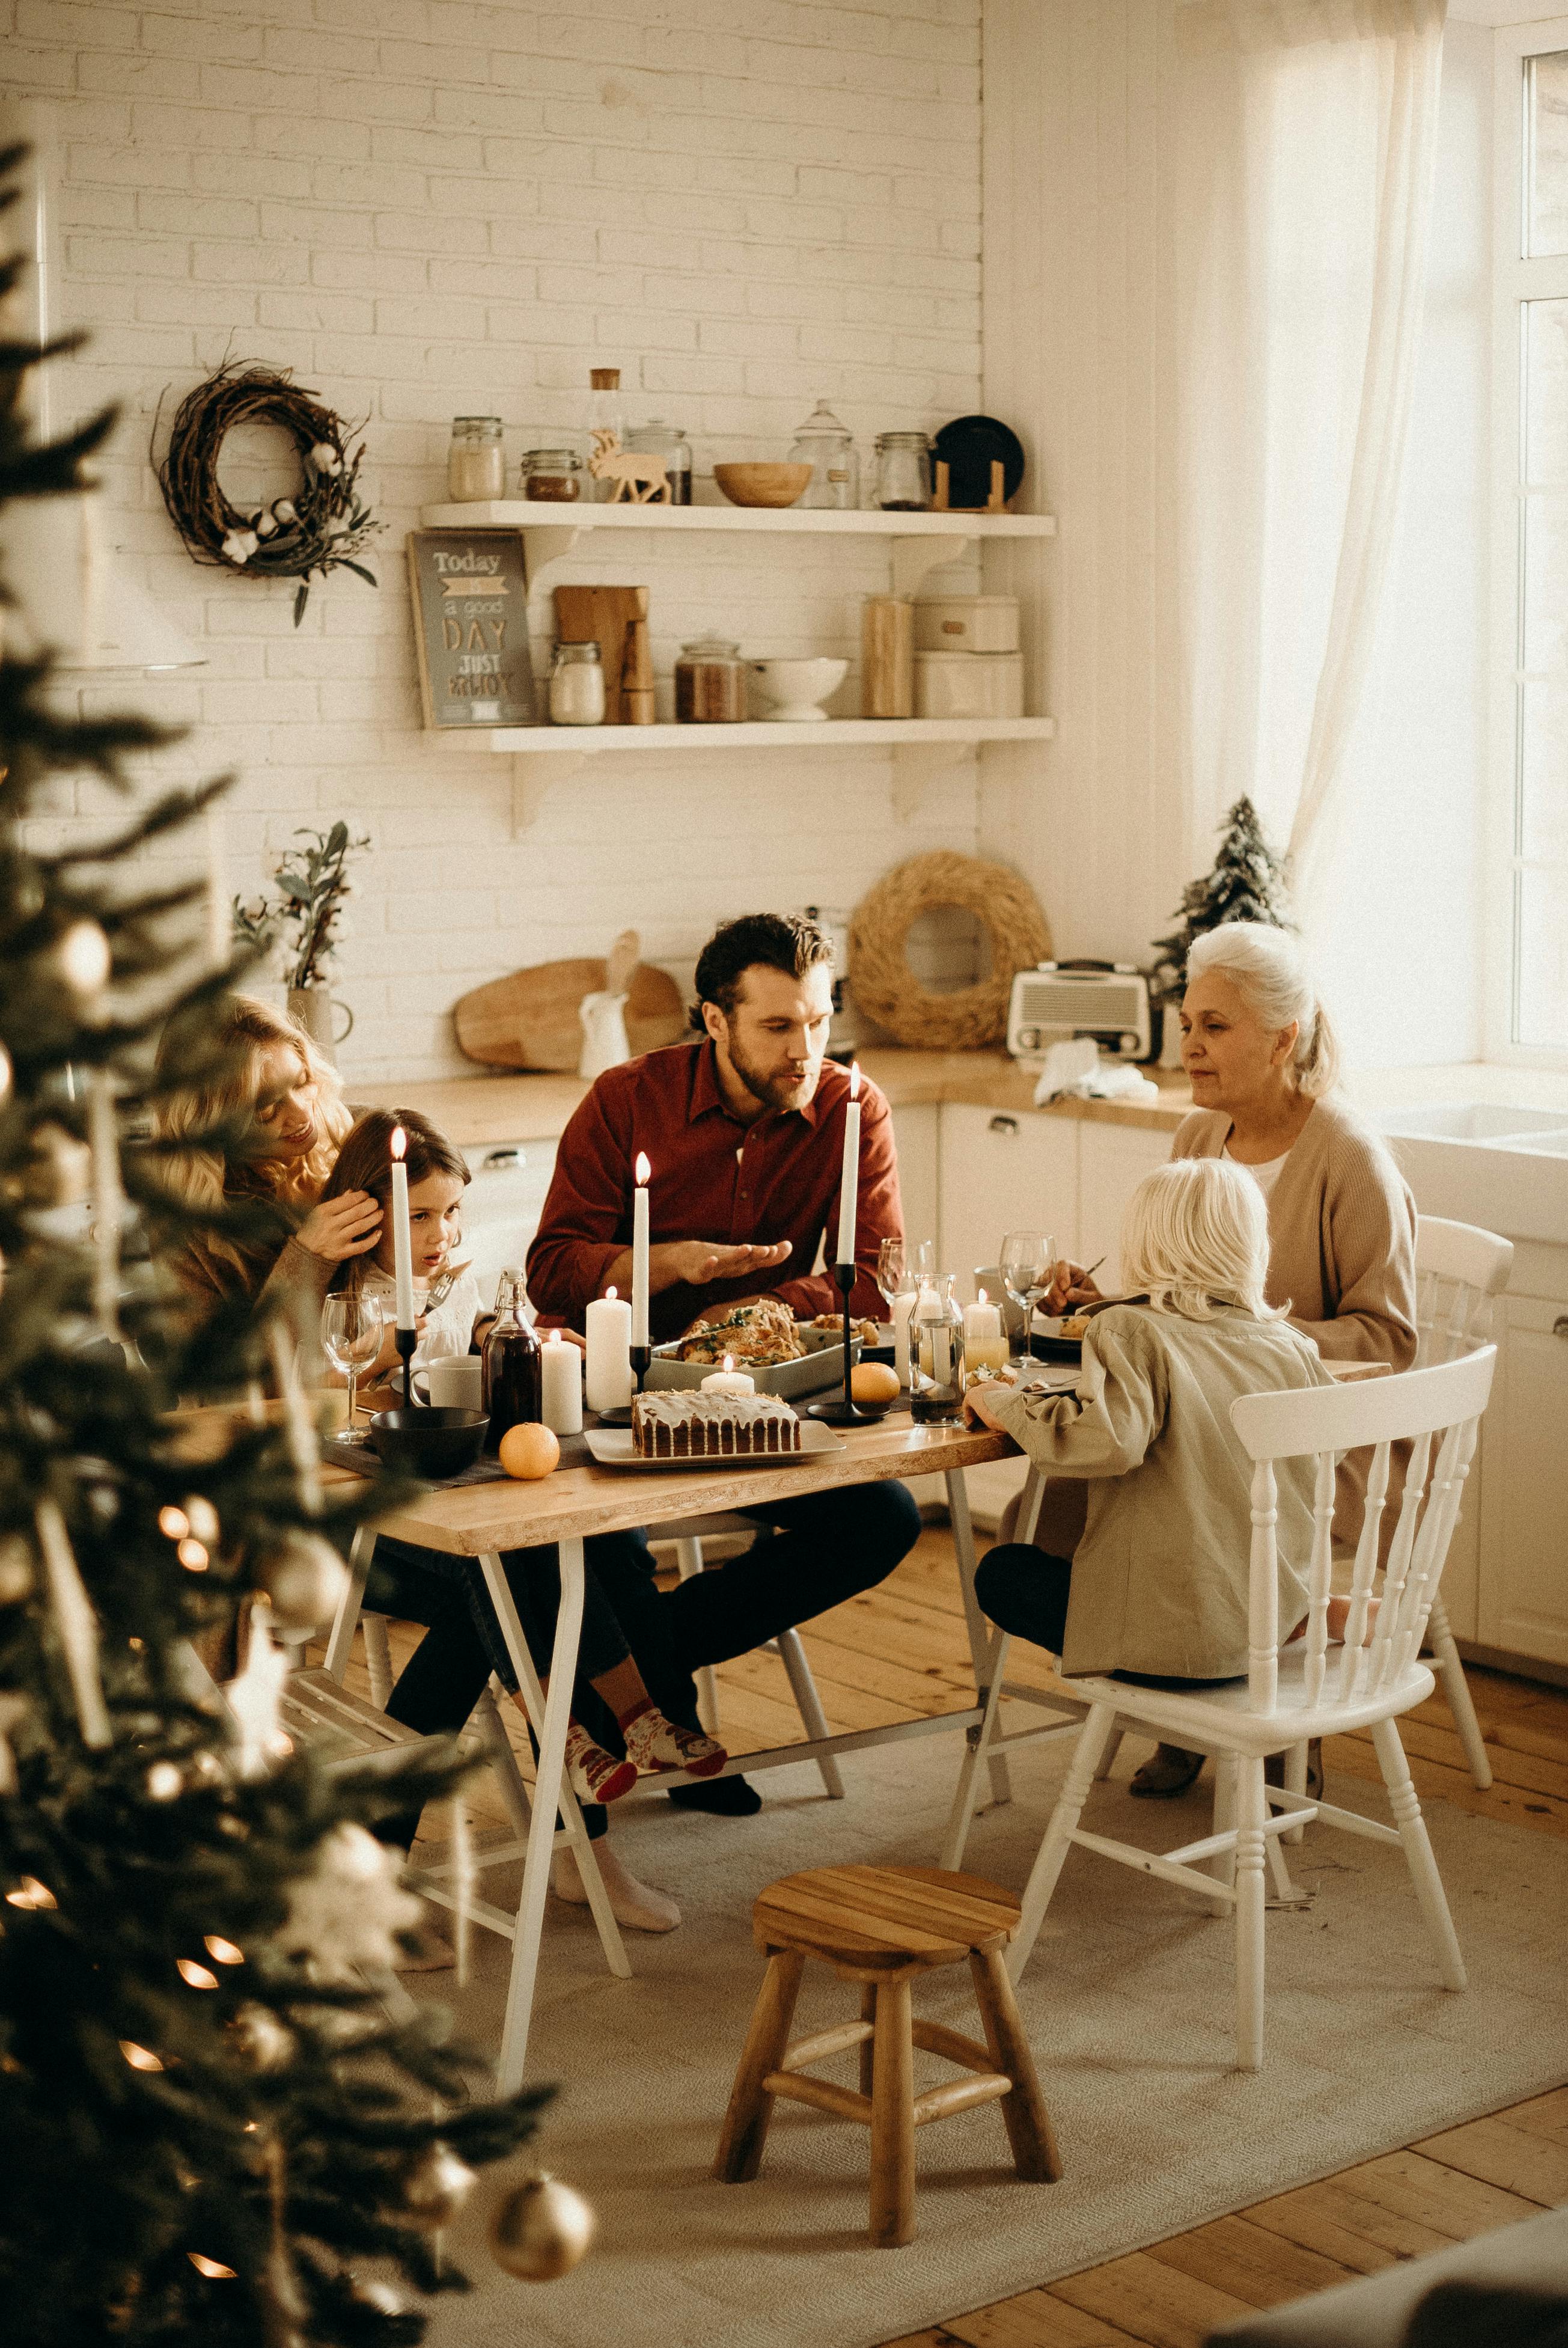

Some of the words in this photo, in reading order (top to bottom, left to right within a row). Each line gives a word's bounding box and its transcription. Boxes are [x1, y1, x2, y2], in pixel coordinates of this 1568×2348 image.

[433, 548, 501, 574] Today
[445, 601, 457, 616] a
[464, 597, 504, 619] good
[442, 618, 505, 650] DAY
[459, 654, 500, 673] JUST
